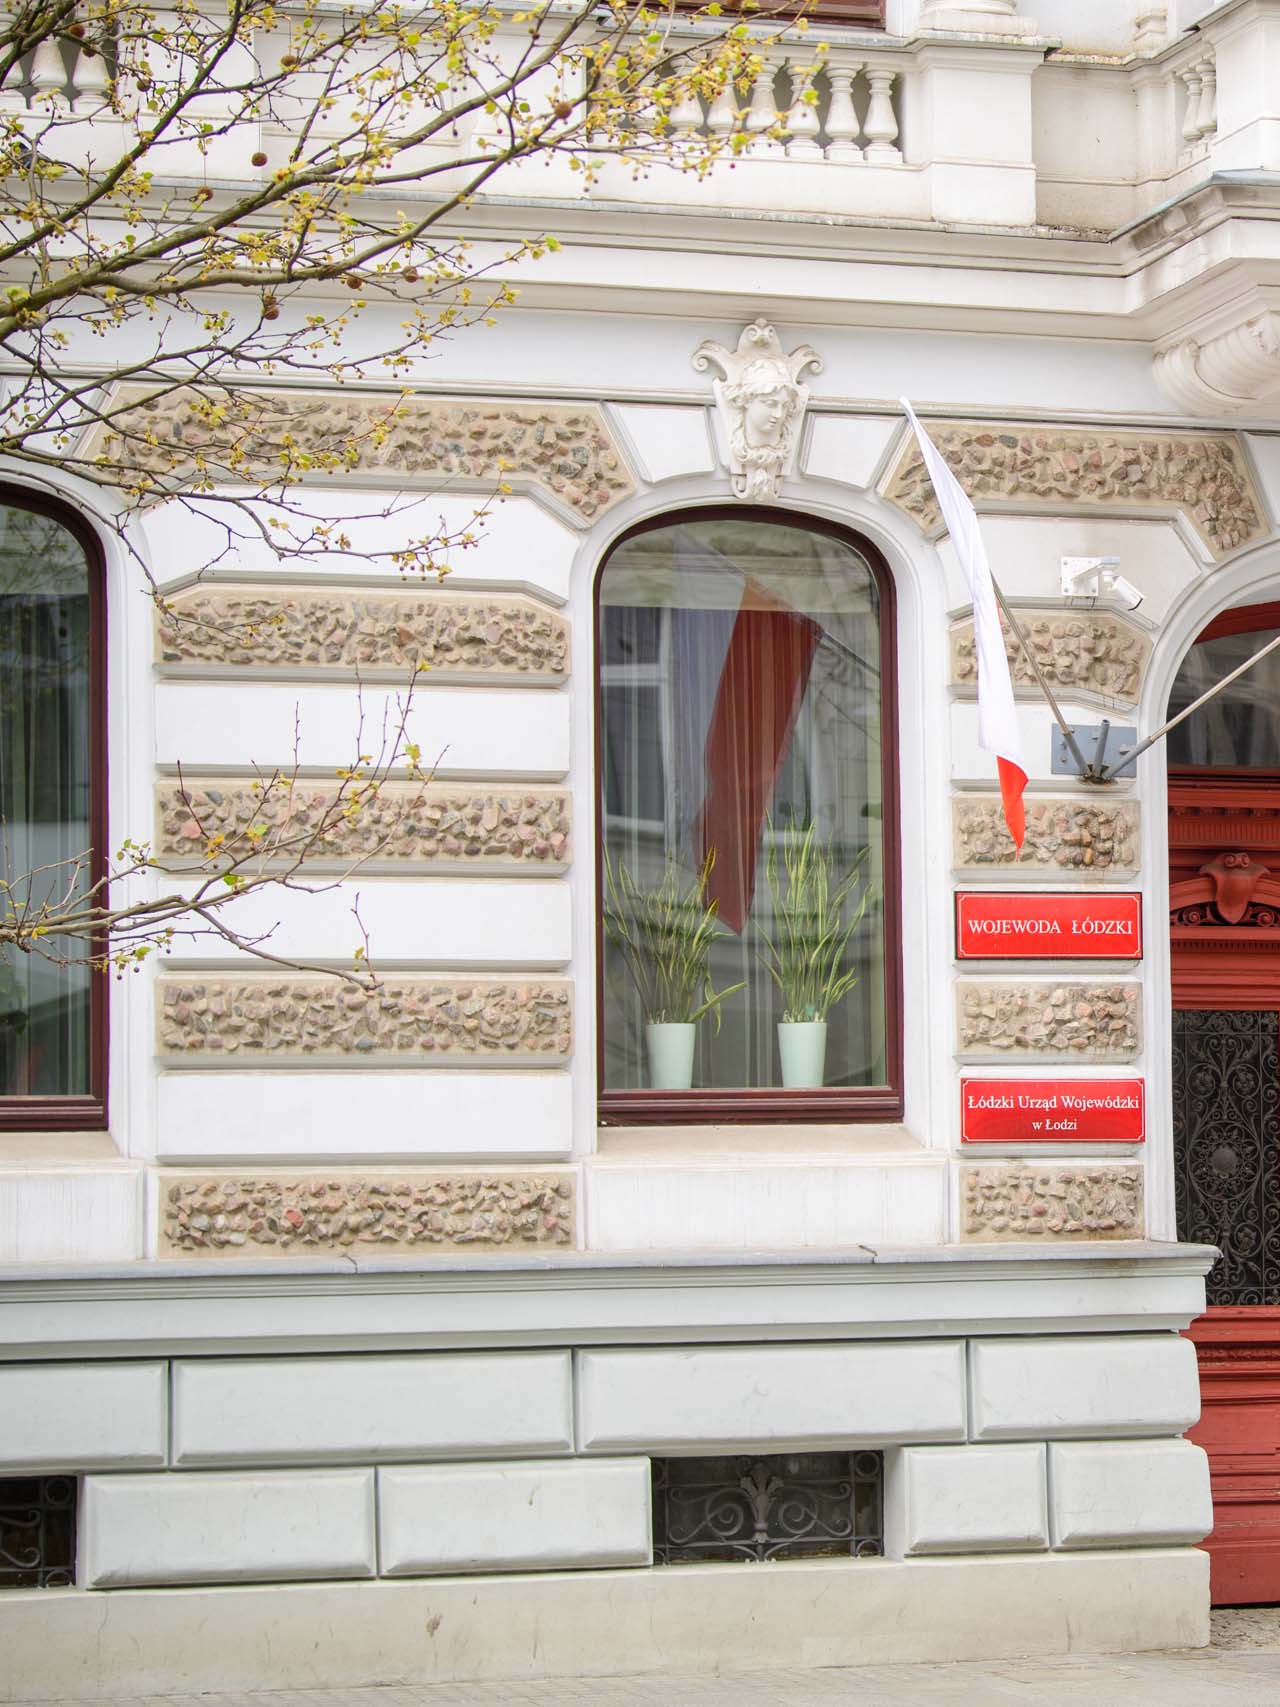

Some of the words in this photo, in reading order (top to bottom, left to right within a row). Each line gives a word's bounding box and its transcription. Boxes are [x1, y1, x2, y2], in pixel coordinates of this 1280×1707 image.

[968, 919, 1062, 934] WOJEWODA
[1071, 916, 1133, 935] ŁÓDZKI
[967, 1095, 1015, 1109] Łódzki
[1018, 1095, 1057, 1112] Urząd
[1060, 1095, 1139, 1111] Wojewódzki
[1032, 1121, 1042, 1130] w
[1045, 1119, 1078, 1130] Łodzi
